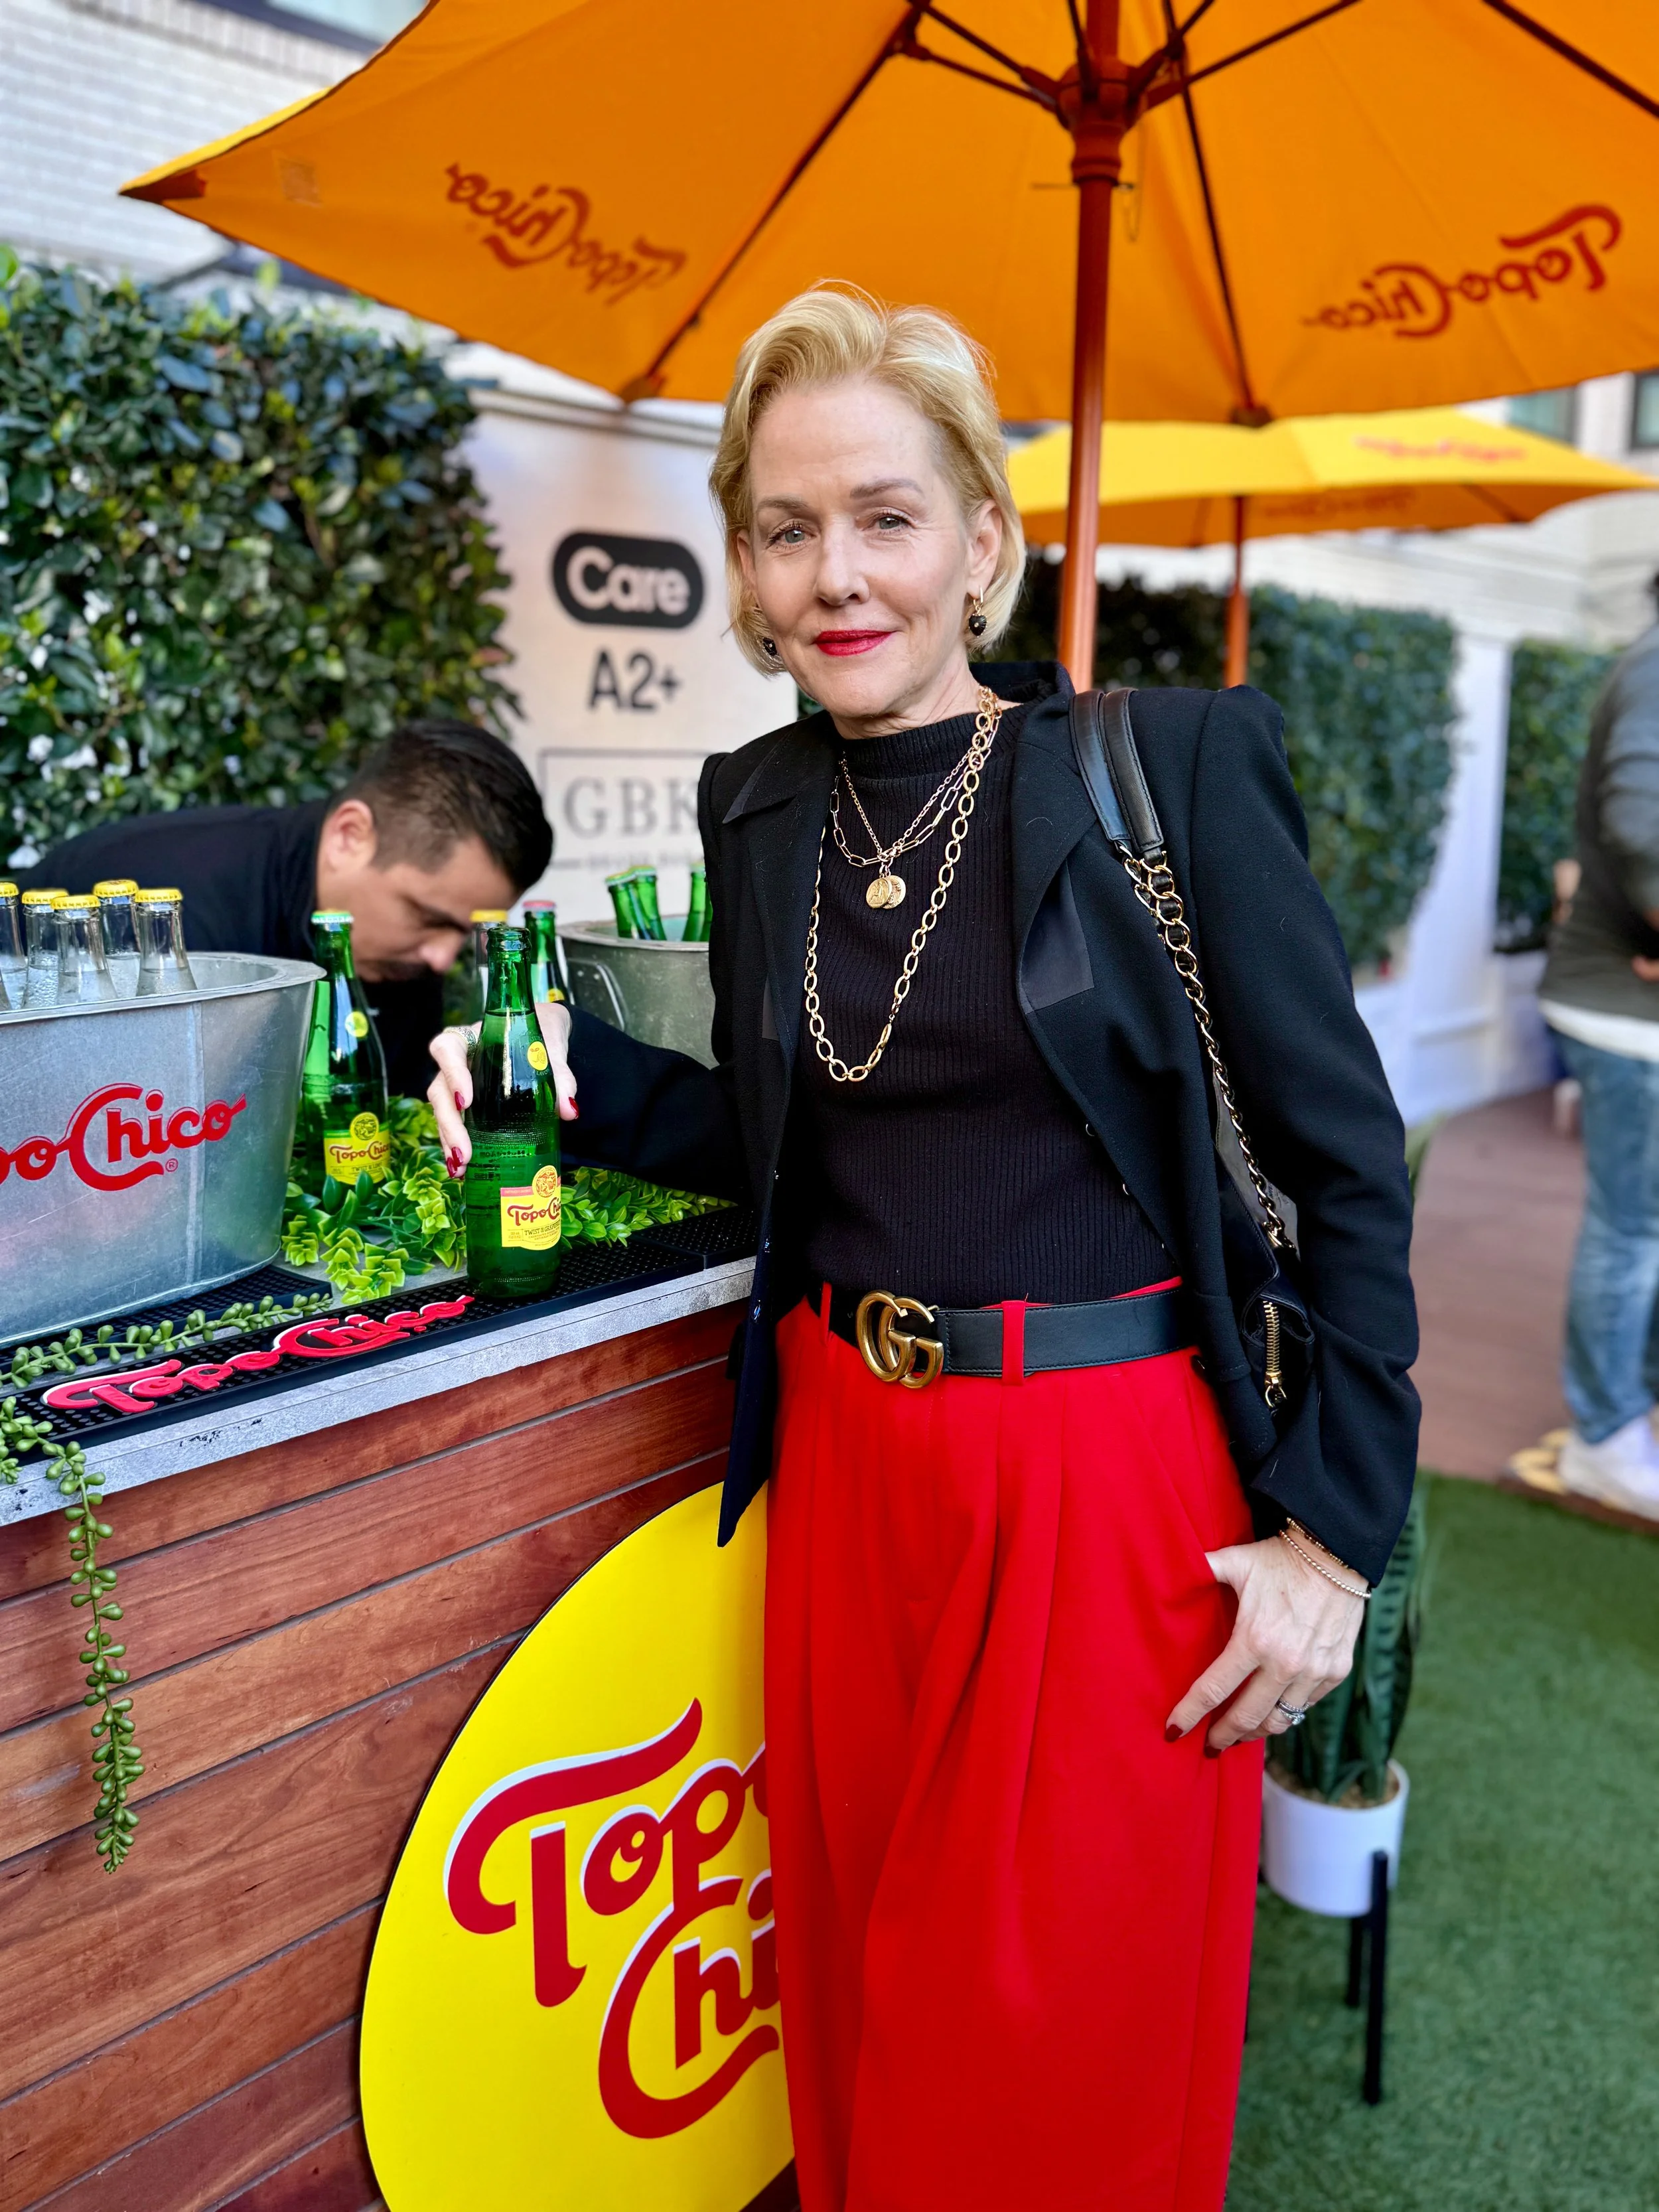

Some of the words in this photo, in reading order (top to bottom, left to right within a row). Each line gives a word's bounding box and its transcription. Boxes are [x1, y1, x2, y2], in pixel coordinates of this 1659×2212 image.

[566, 545, 691, 616] Care
[587, 648, 680, 711] A2+
[563, 775, 699, 839] GBK
[66, 1082, 248, 1192] Chico
[329, 1145, 367, 1164] Topo
[507, 1204, 547, 1226] Topo
[41, 1351, 281, 1414] Topo
[272, 1294, 476, 1358] Chico
[443, 1696, 768, 2008] Top
